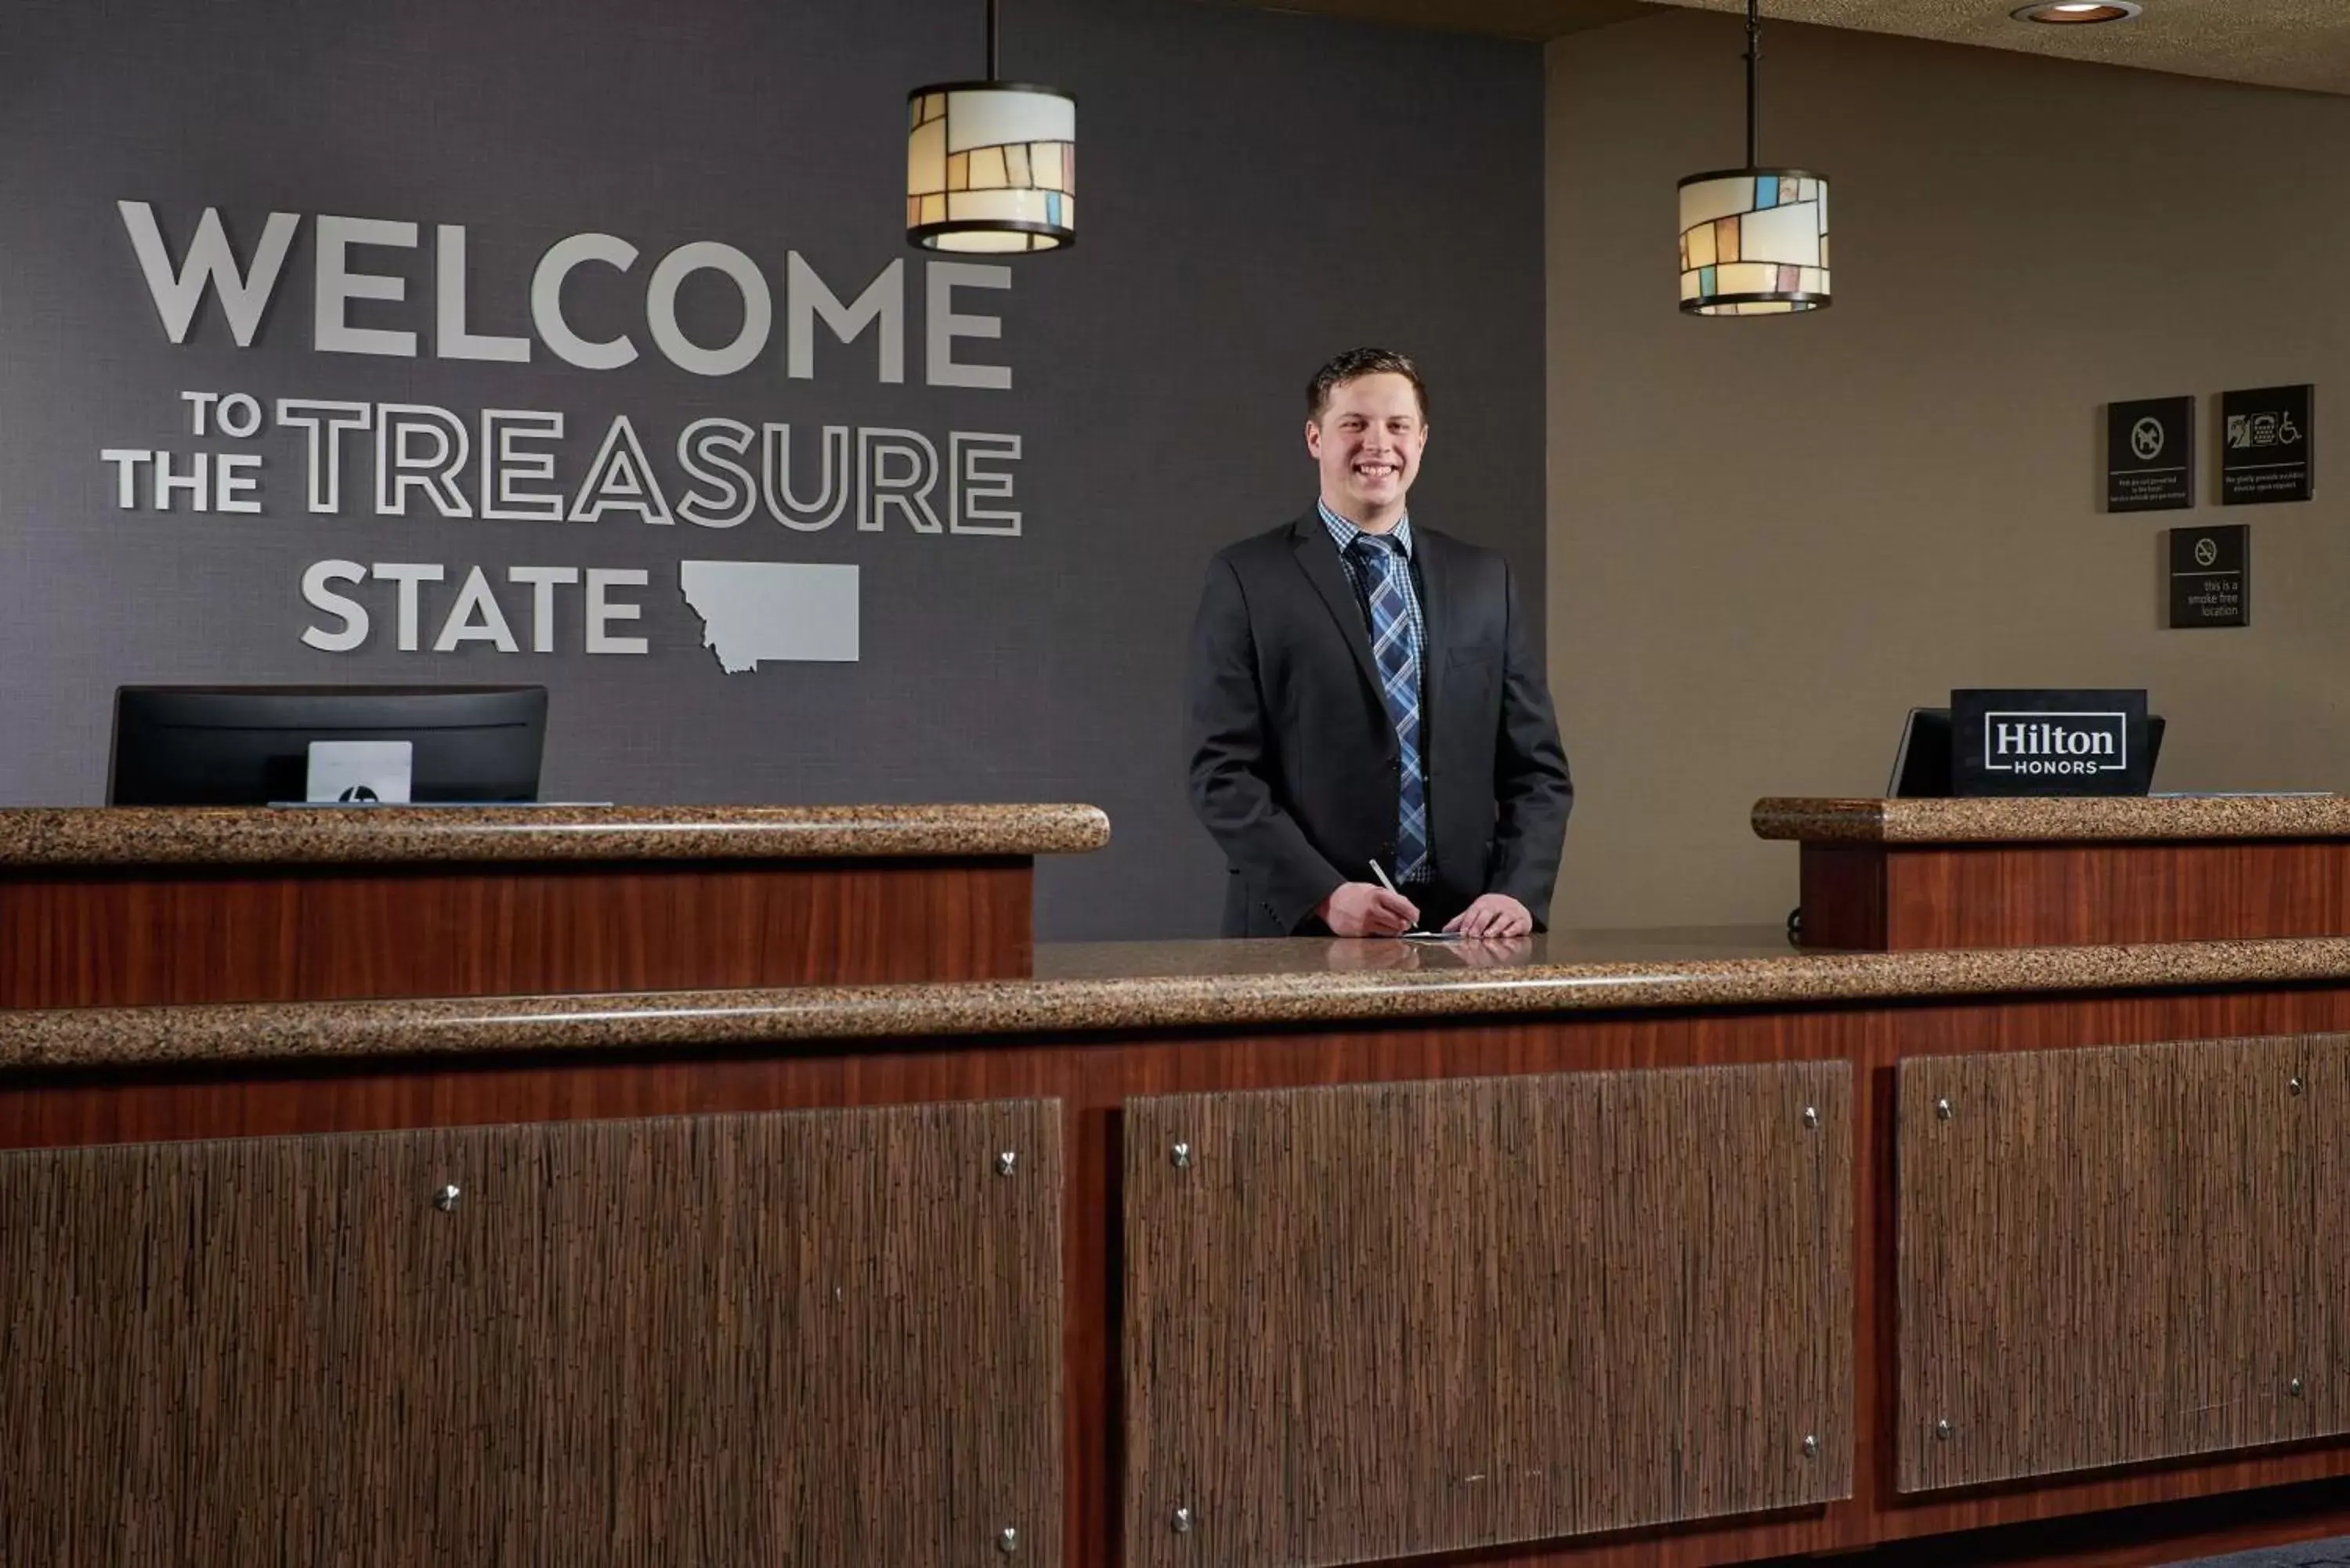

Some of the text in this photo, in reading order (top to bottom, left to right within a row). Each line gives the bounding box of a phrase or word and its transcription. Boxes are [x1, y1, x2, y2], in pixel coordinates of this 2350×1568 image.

[118, 201, 1010, 388] WELCOME
[181, 392, 261, 437] TO
[100, 449, 262, 513] THE
[277, 399, 1021, 536] TREASURE
[2188, 591, 2238, 605] smoke free
[2204, 580, 2221, 591] this
[2223, 580, 2230, 590] is
[302, 559, 648, 653] STATE
[2203, 605, 2238, 616] location
[1997, 723, 2114, 754] Hilton
[2015, 761, 2097, 775] HONORS
